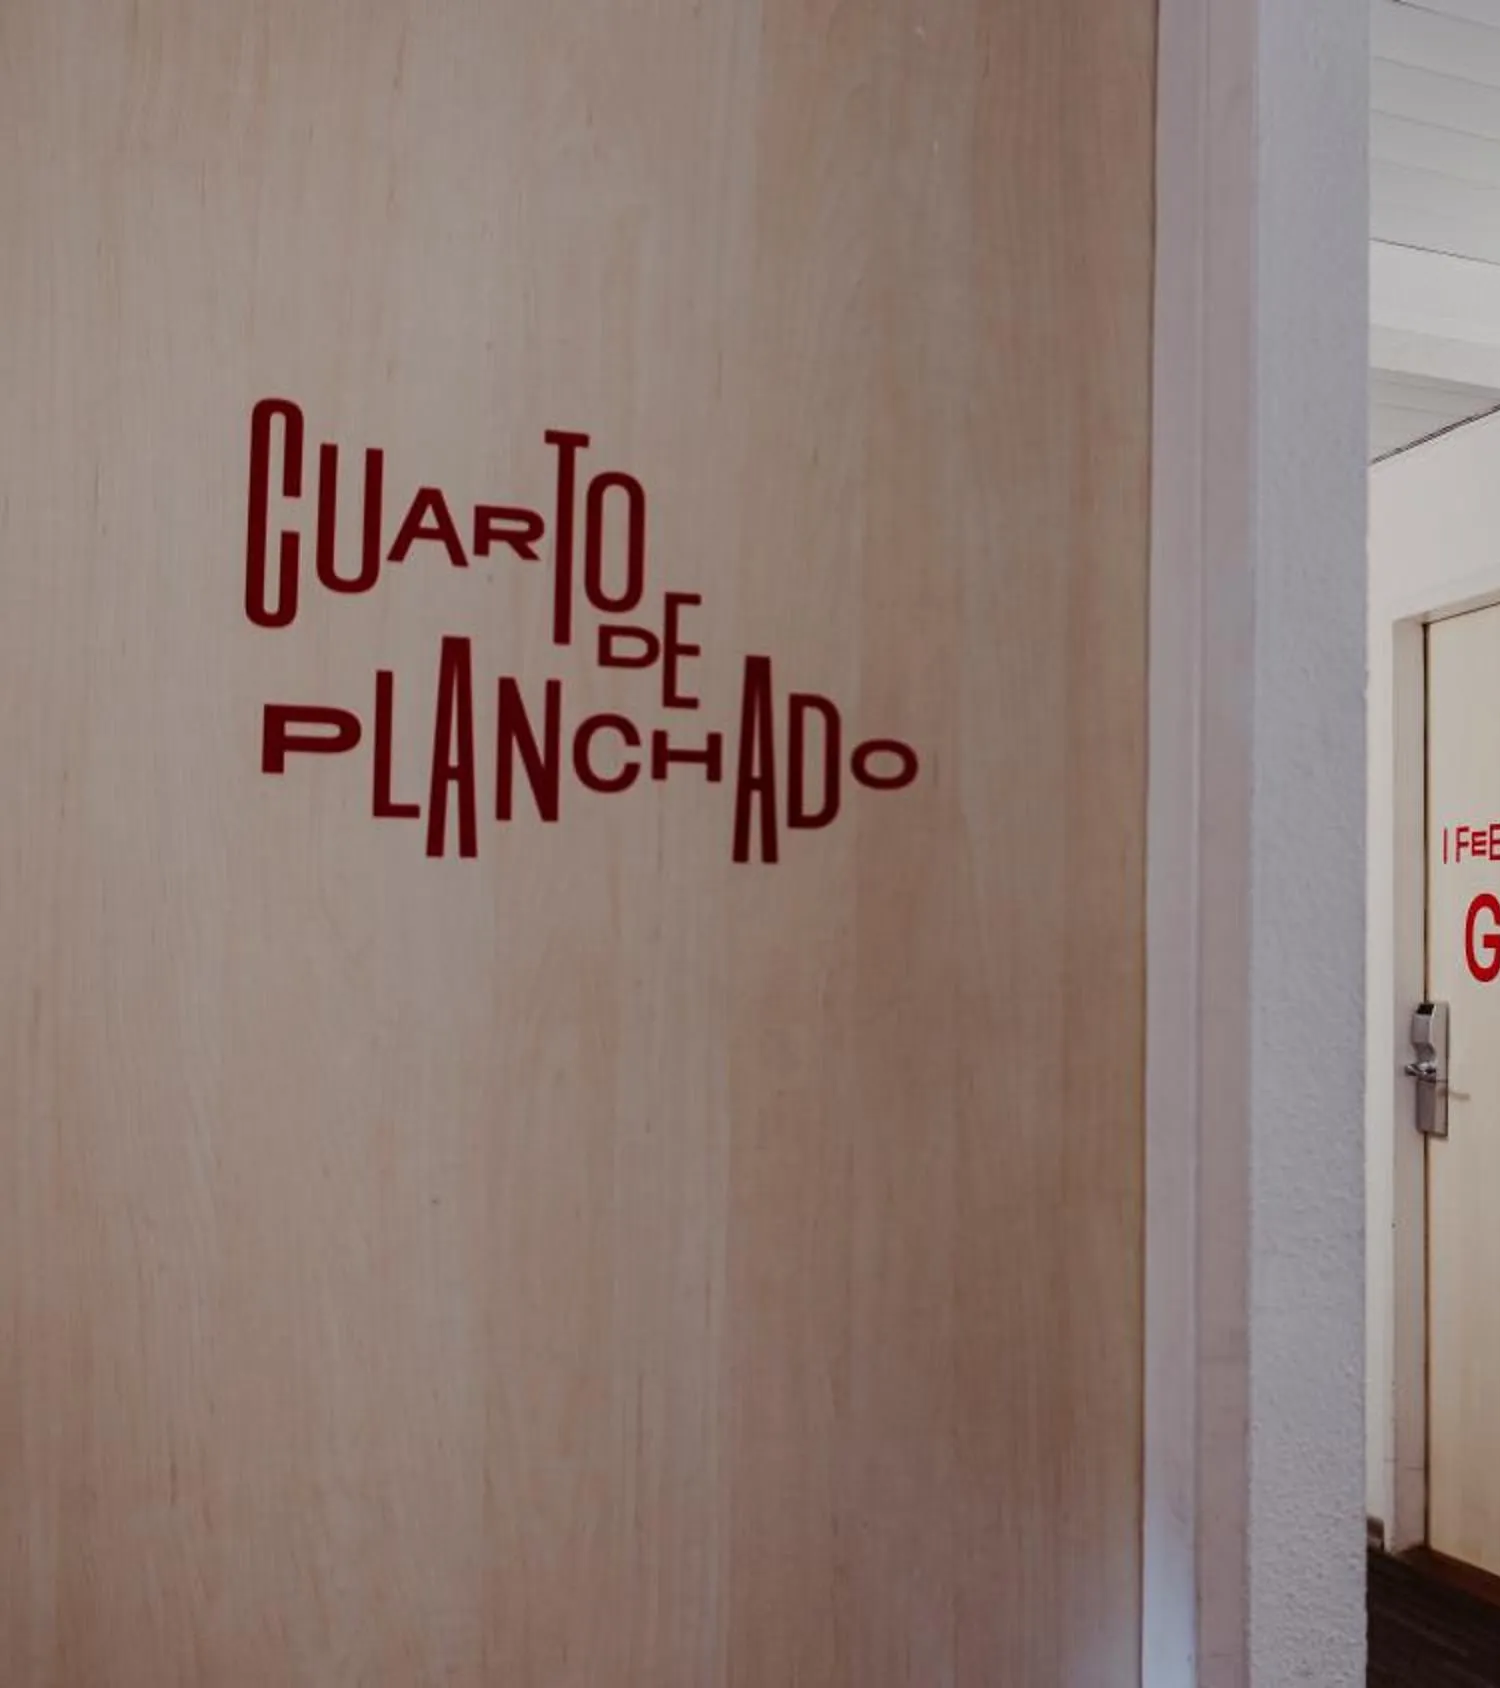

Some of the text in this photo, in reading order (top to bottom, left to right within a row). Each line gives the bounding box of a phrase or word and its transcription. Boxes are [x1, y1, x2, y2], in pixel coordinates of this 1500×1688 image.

[245, 398, 646, 645] CUARTO
[598, 592, 702, 710] DE
[261, 636, 919, 864] PLANCHADO
[1443, 827, 1448, 865] I
